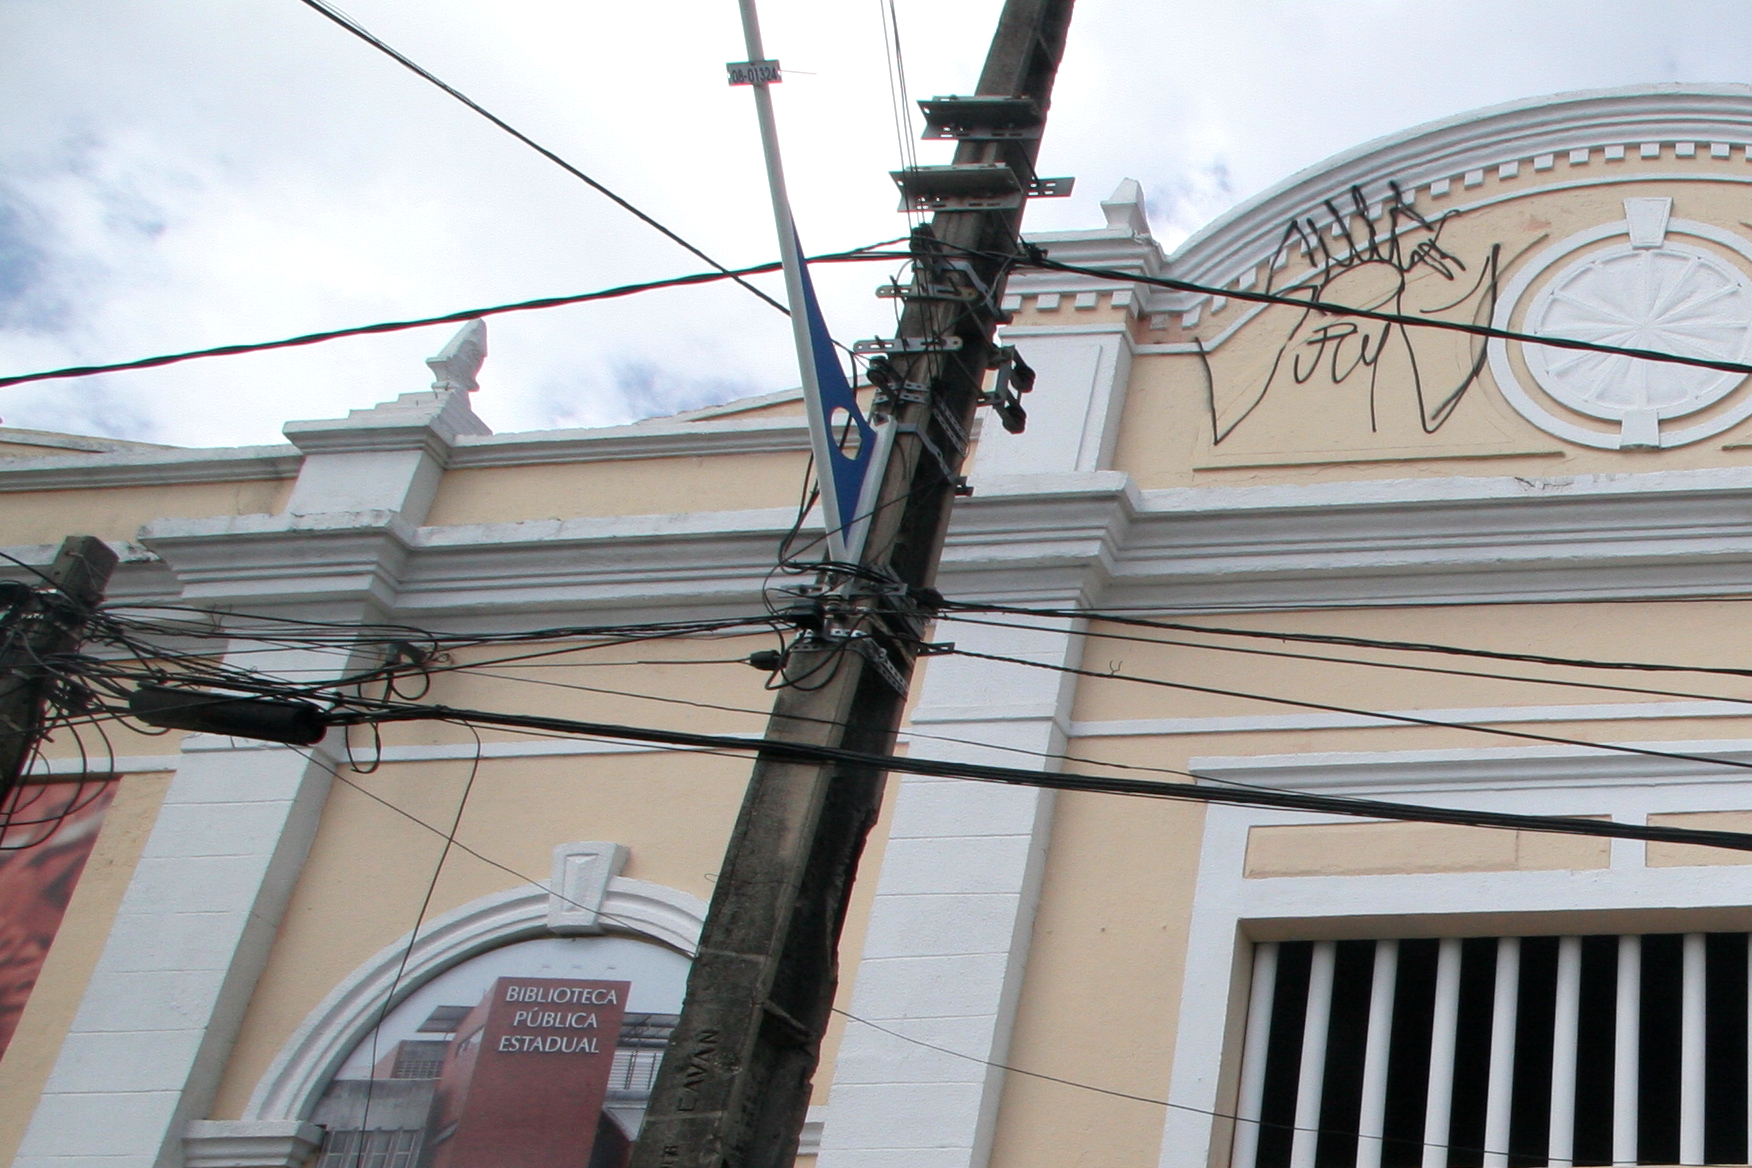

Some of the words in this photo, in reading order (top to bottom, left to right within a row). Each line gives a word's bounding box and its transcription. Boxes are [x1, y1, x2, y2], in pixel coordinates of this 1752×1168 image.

[504, 985, 618, 1006] BIBLIOTECA
[512, 1006, 598, 1029] PÚBLICA
[498, 1035, 600, 1054] ESTADUAL
